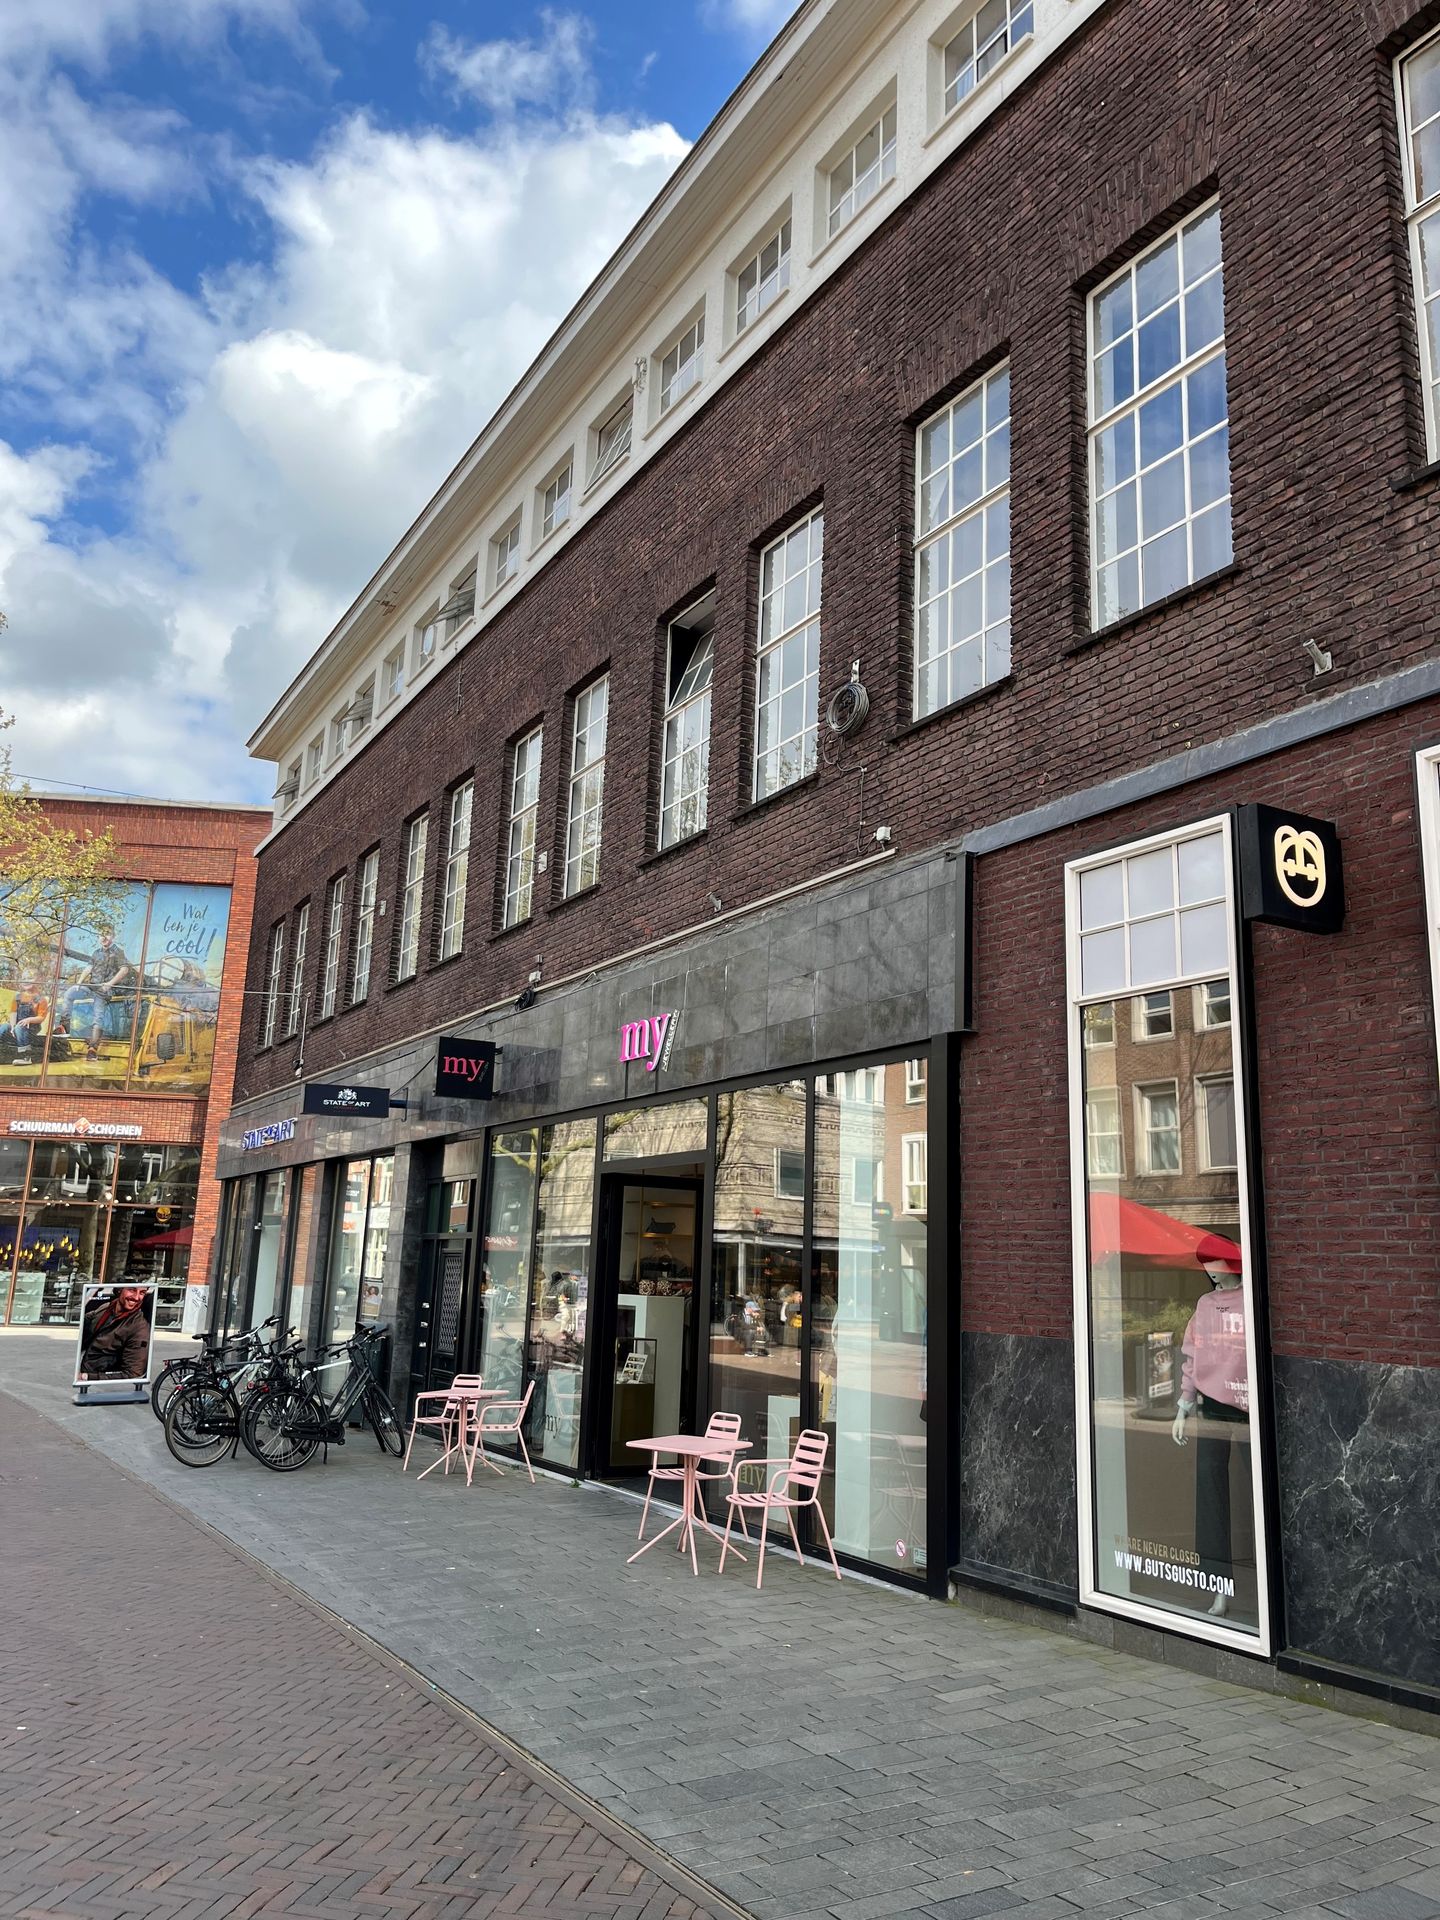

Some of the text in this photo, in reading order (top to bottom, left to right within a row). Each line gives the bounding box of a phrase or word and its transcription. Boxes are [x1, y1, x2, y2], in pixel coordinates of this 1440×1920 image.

[163, 915, 199, 941] ben je
[166, 927, 217, 963] cool!
[619, 1013, 671, 1071] my
[443, 1056, 485, 1082] my
[9, 1120, 143, 1136] SCHUURMAN SCHOENEN
[242, 1127, 267, 1151] STATE
[274, 1117, 298, 1143] ART
[1128, 1536, 1142, 1552] ARE
[1142, 1540, 1169, 1559] NEVER
[1169, 1546, 1200, 1566] CLOSED
[1114, 1550, 1235, 1597] WWW.GUTSGUSTO.COM
